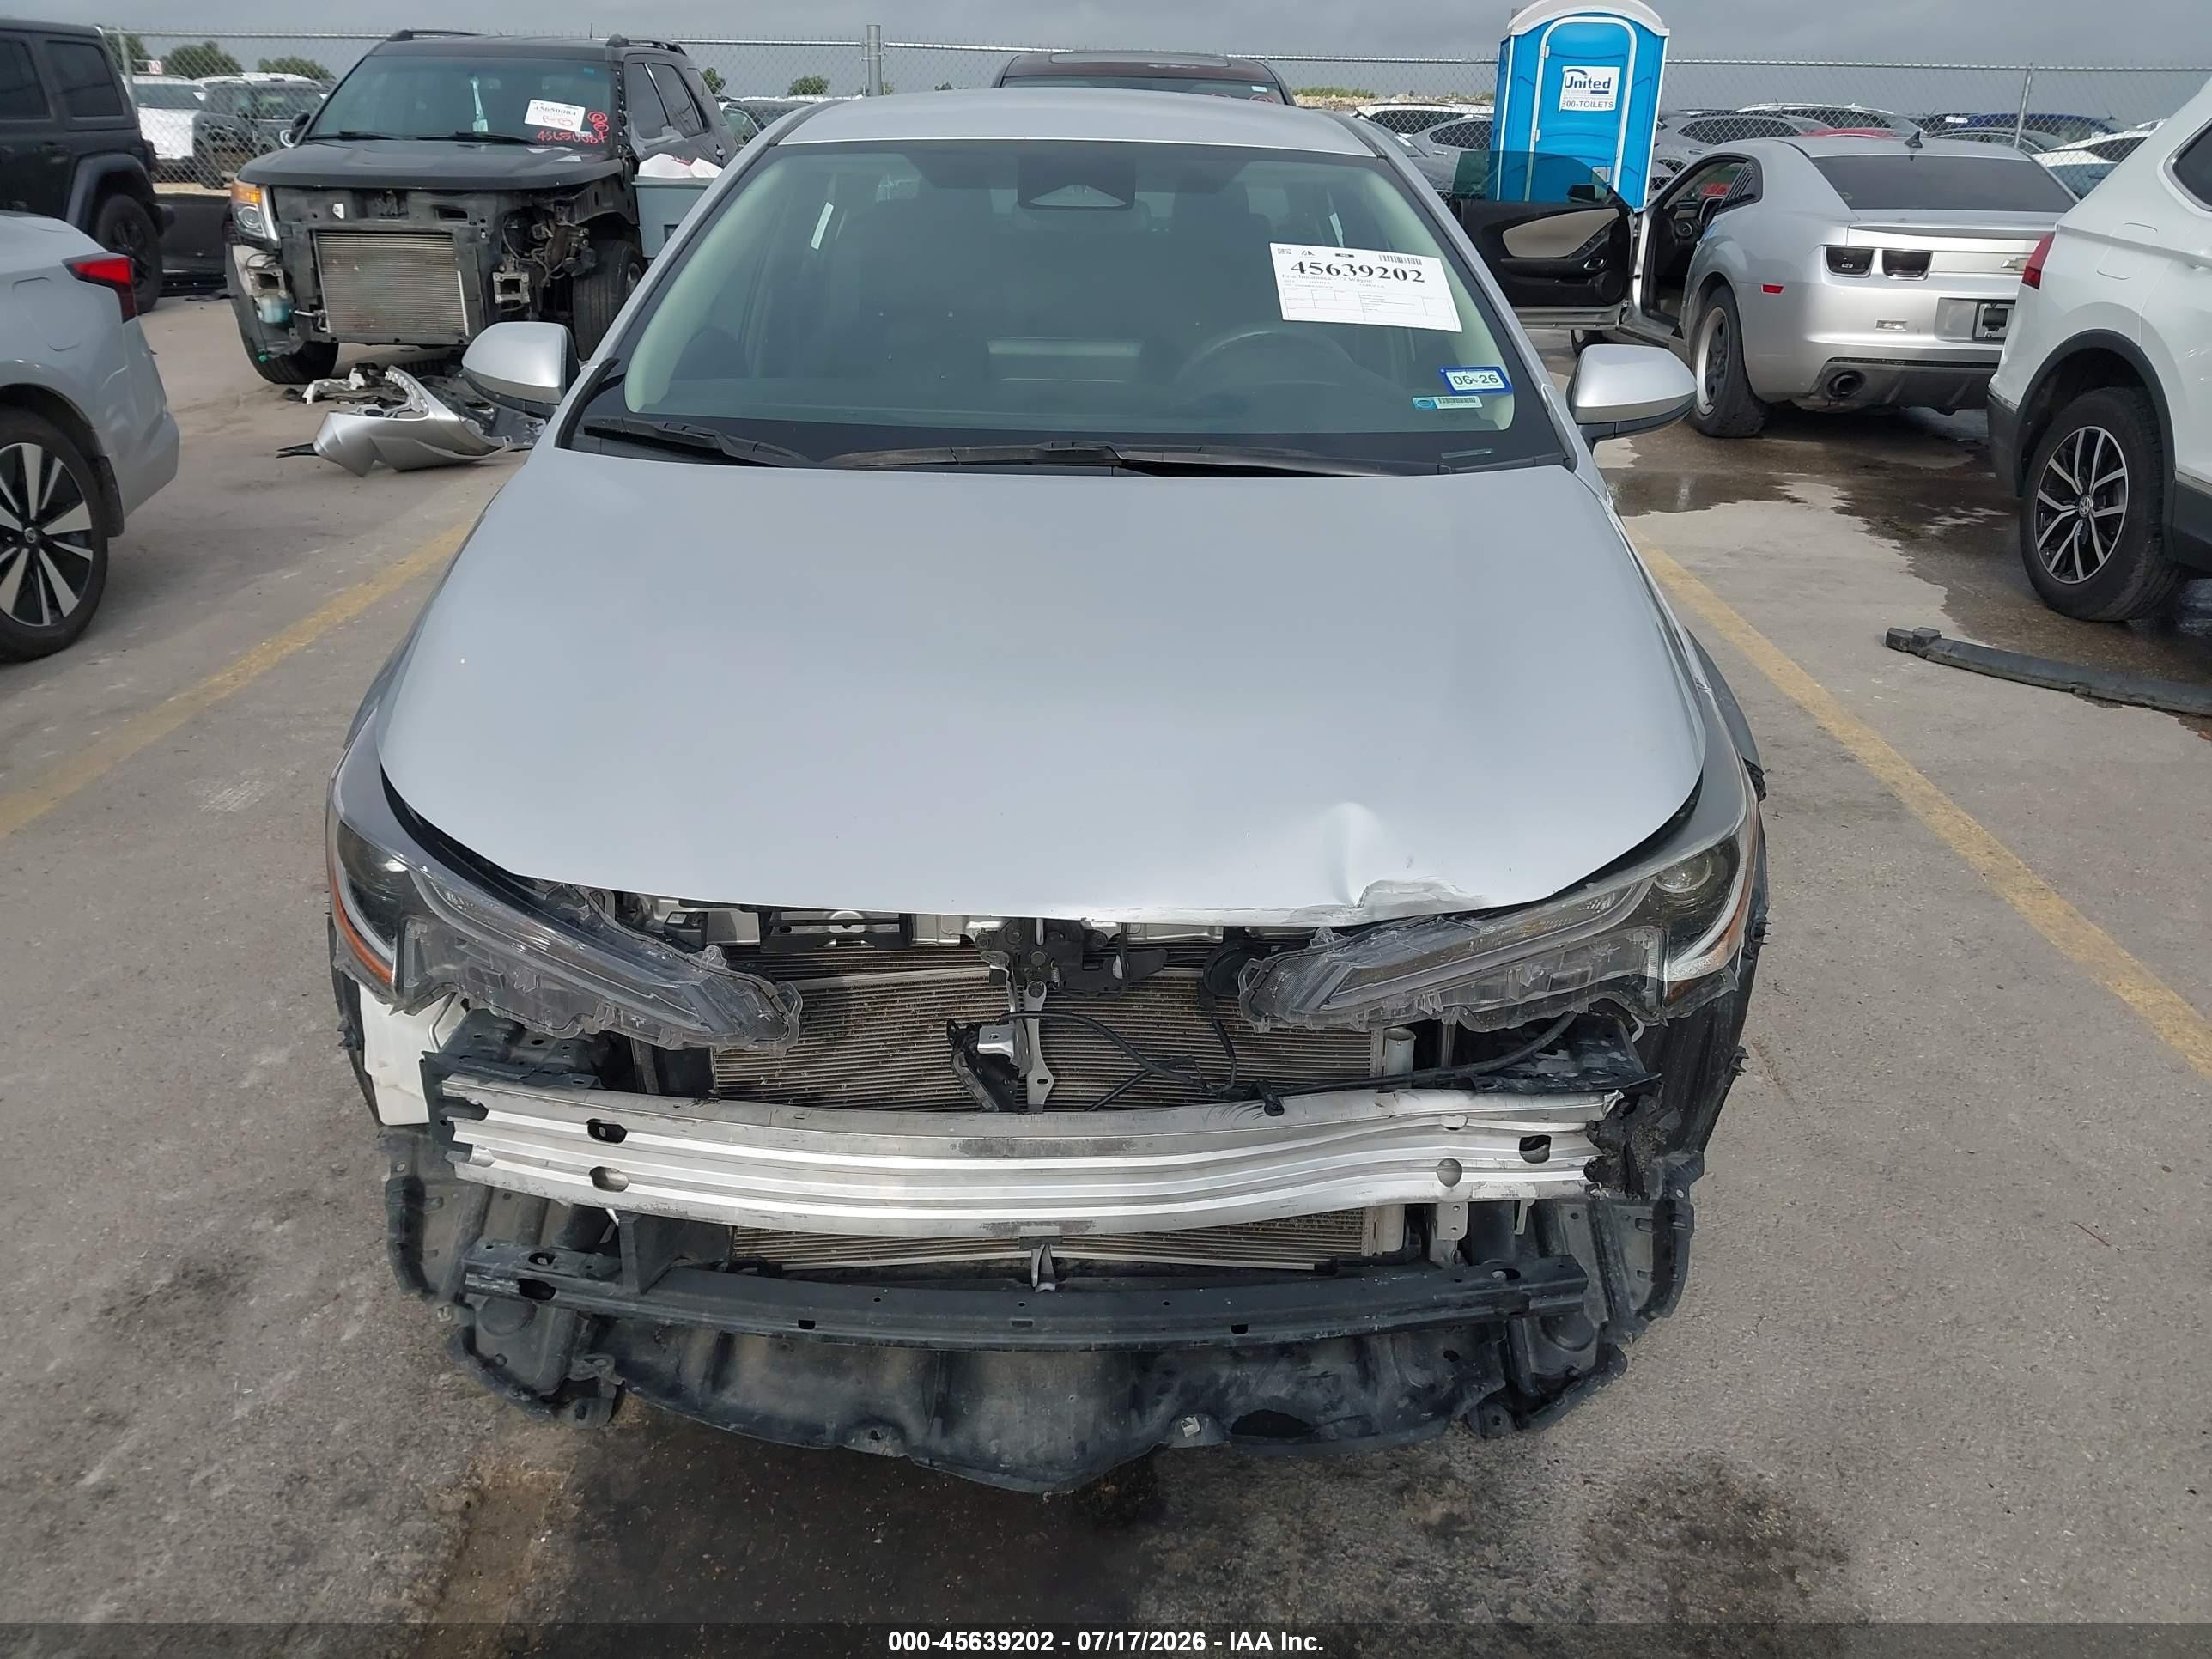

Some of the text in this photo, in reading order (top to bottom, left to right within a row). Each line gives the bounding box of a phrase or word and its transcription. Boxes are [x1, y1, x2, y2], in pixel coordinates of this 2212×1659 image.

[1565, 76, 1612, 89] United
[1291, 261, 1425, 283] 45639202
[1453, 374, 1499, 385] 06 26
